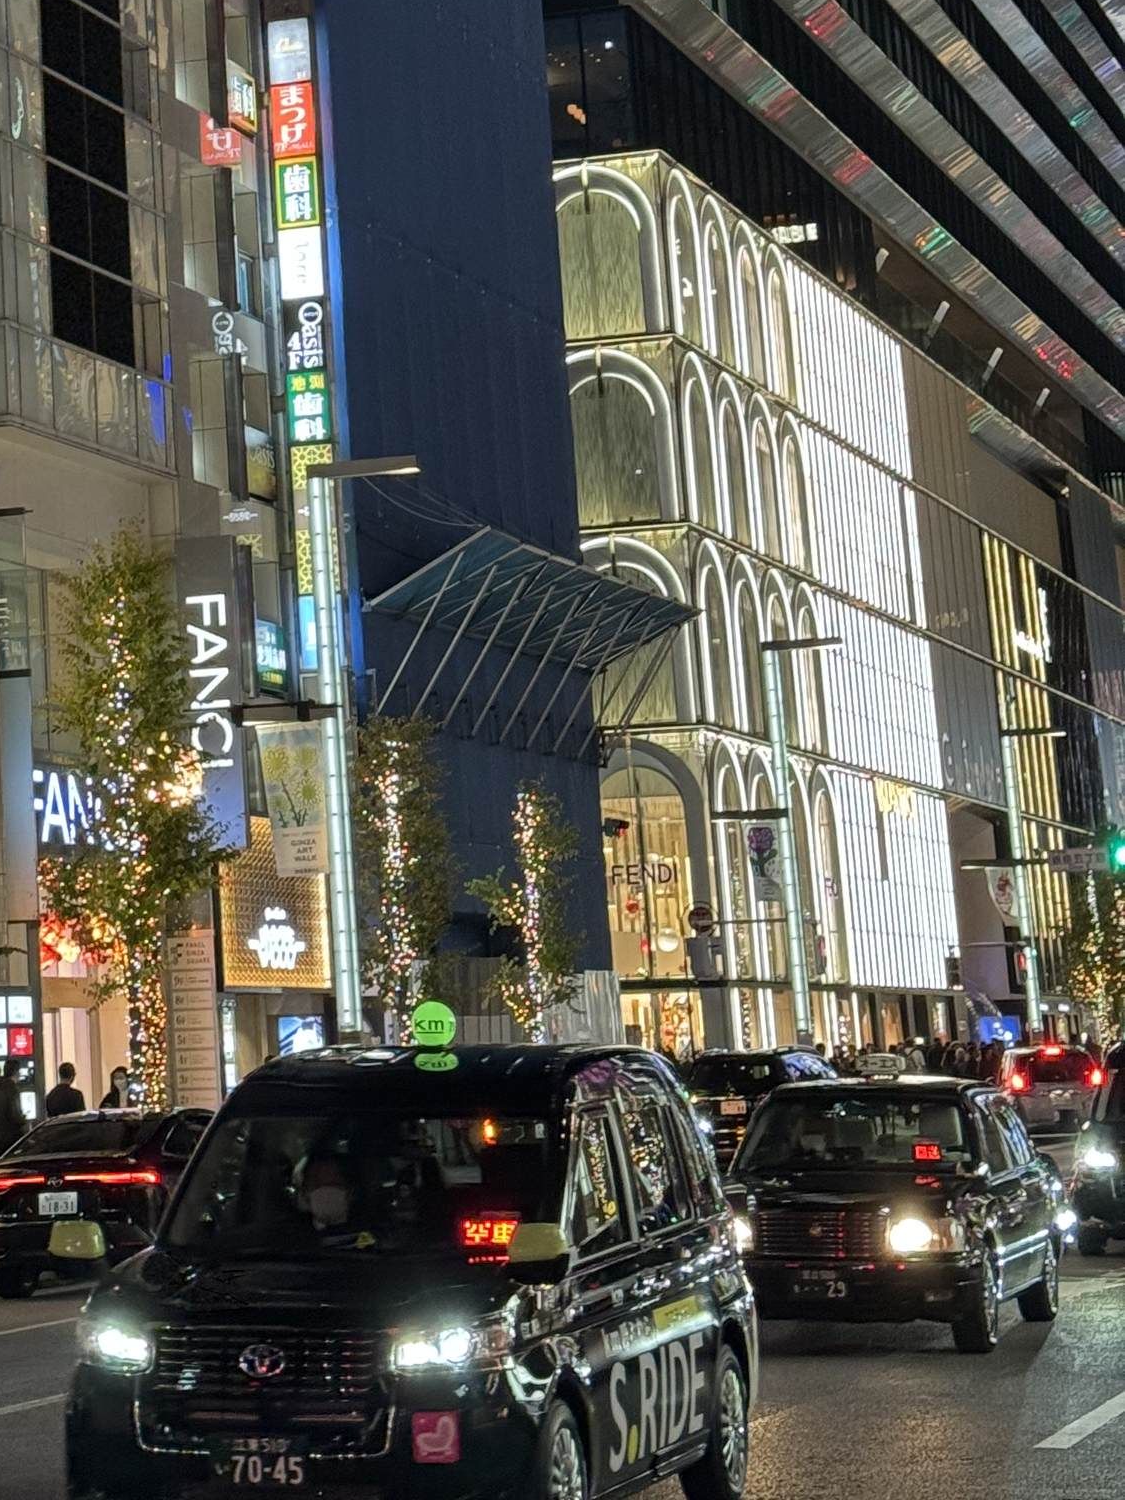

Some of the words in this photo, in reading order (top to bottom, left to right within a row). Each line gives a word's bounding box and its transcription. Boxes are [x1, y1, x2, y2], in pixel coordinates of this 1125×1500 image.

[279, 85, 307, 144] まつげ
[283, 163, 313, 221] 歯科
[298, 301, 324, 368] Oasis
[611, 862, 679, 885] FENDI
[464, 1220, 518, 1246] 空車
[609, 1331, 705, 1473] S.RIDE
[231, 1455, 303, 1485] 70-45
